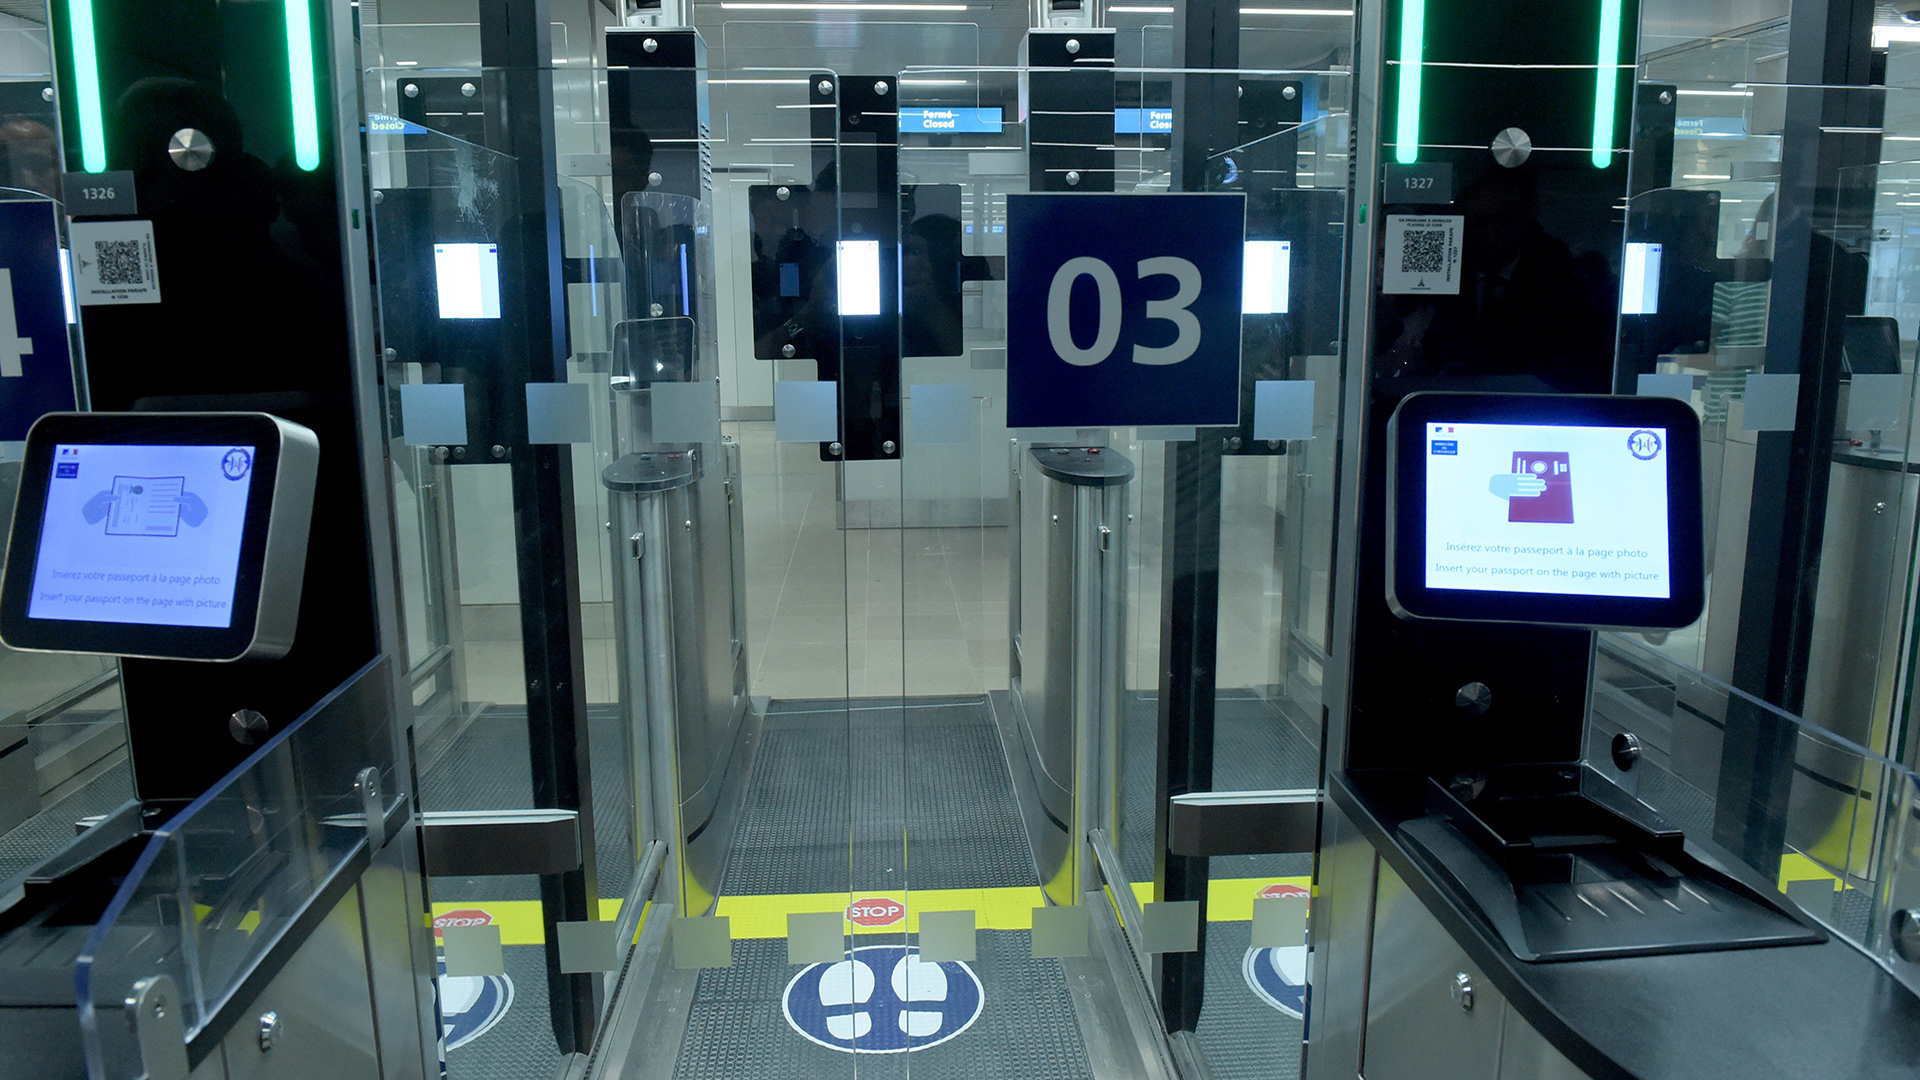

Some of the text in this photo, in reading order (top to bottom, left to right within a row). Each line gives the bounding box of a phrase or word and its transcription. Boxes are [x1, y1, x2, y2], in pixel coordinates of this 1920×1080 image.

[923, 109, 952, 119] Fermé
[923, 119, 954, 129] Closed
[1403, 177, 1434, 189] 1327
[82, 187, 116, 200] 1326
[1047, 256, 1202, 366] 03
[1446, 541, 1648, 559] Insérez votre passeport à la page photo
[1435, 562, 1463, 573] Insert
[1466, 565, 1488, 575] your
[1491, 566, 1533, 577] passport
[1552, 568, 1569, 577] the
[1571, 569, 1597, 580] page
[1599, 569, 1621, 579] with
[1623, 570, 1660, 581] picture
[83, 571, 106, 580] votre
[107, 572, 150, 584] passeport
[159, 573, 167, 583] la
[169, 575, 191, 587] page
[193, 574, 220, 587] photo
[64, 594, 83, 604] your
[84, 594, 120, 605] passport
[122, 597, 134, 605] on
[136, 596, 150, 606] the
[152, 598, 173, 609] page
[175, 596, 194, 607] with
[195, 598, 227, 610] picture
[852, 906, 900, 918] STOP
